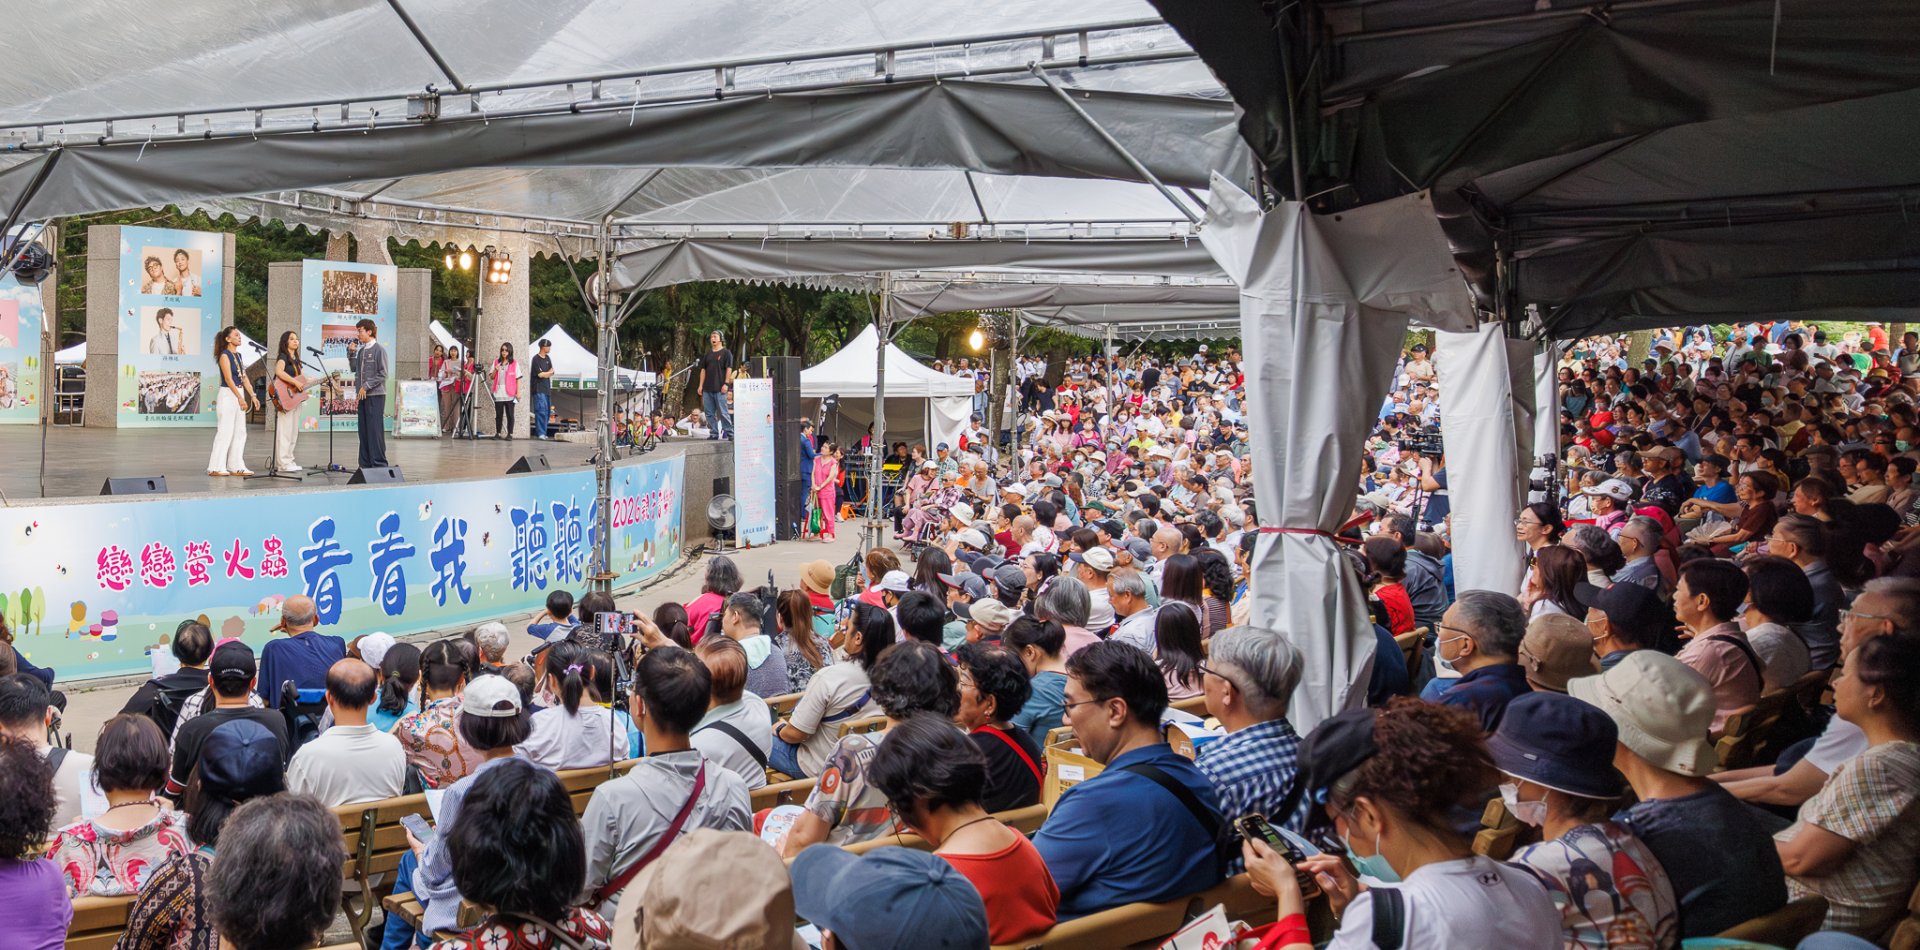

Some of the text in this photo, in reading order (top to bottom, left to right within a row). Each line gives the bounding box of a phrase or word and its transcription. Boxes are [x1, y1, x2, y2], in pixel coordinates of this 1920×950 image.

[96, 535, 288, 591] 戀戀螢火蟲
[298, 510, 473, 626] 看看我
